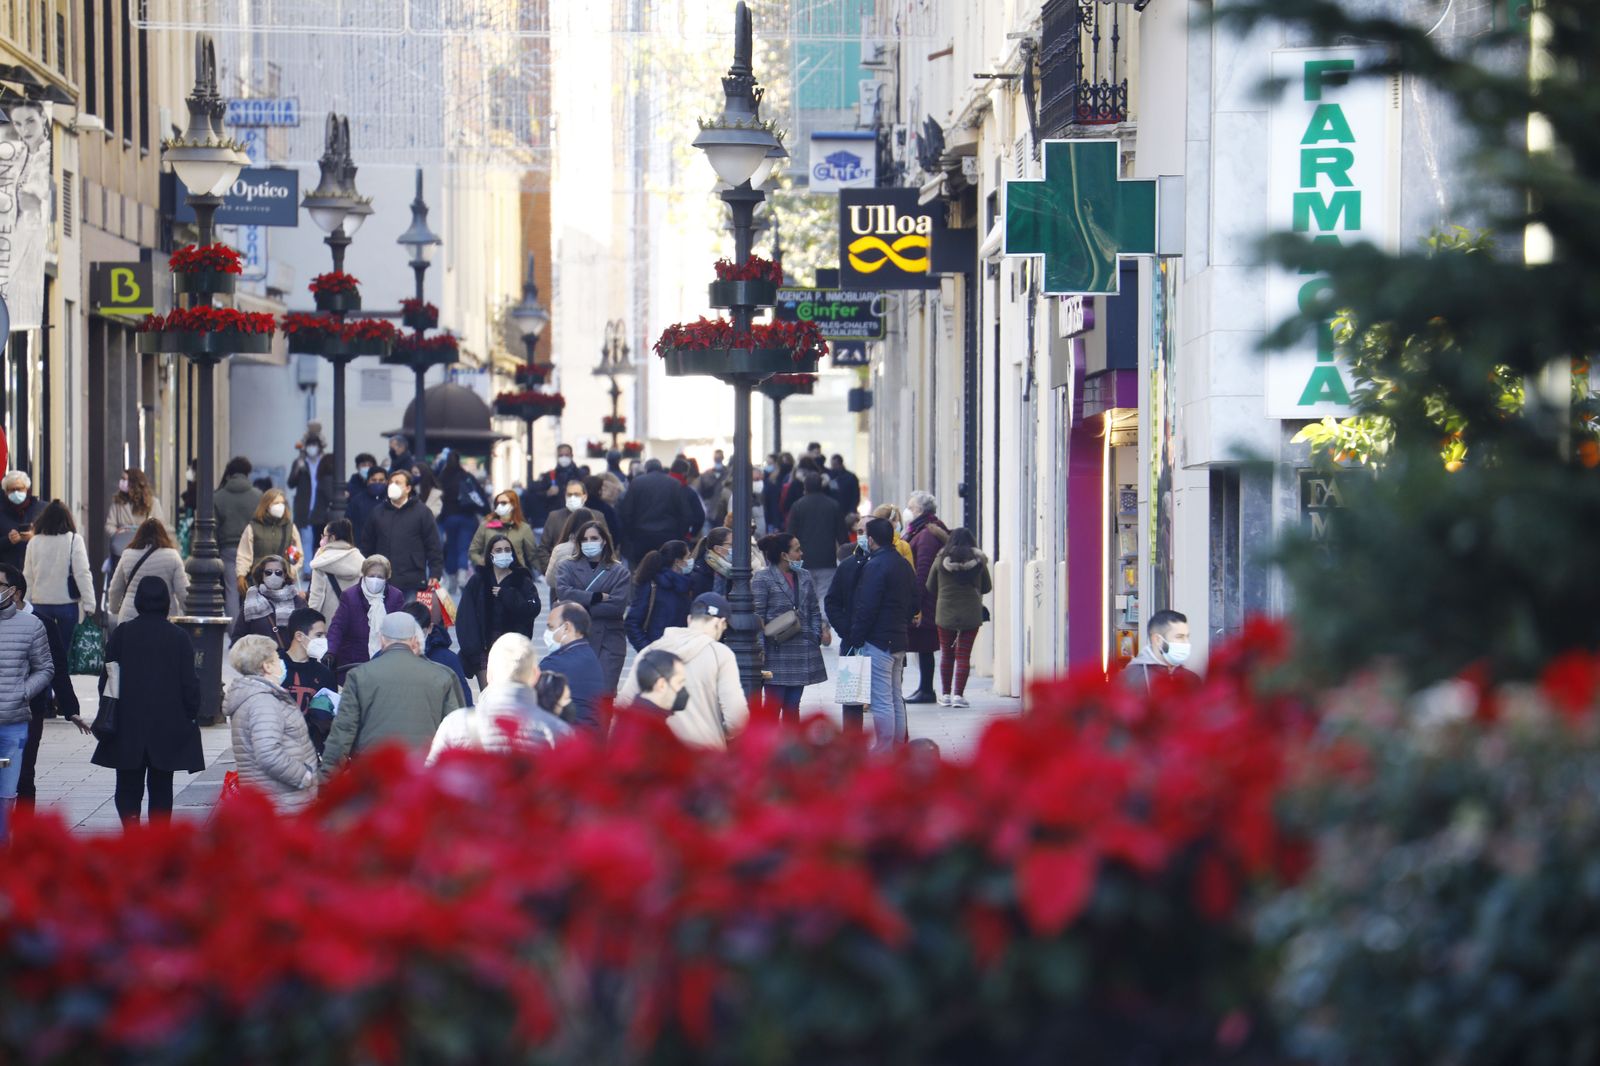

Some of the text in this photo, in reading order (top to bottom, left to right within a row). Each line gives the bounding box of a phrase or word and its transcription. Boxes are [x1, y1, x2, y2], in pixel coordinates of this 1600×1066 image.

[848, 205, 932, 235] Ulloa
[1292, 59, 1361, 406] FARMCIA
[111, 267, 141, 303] B
